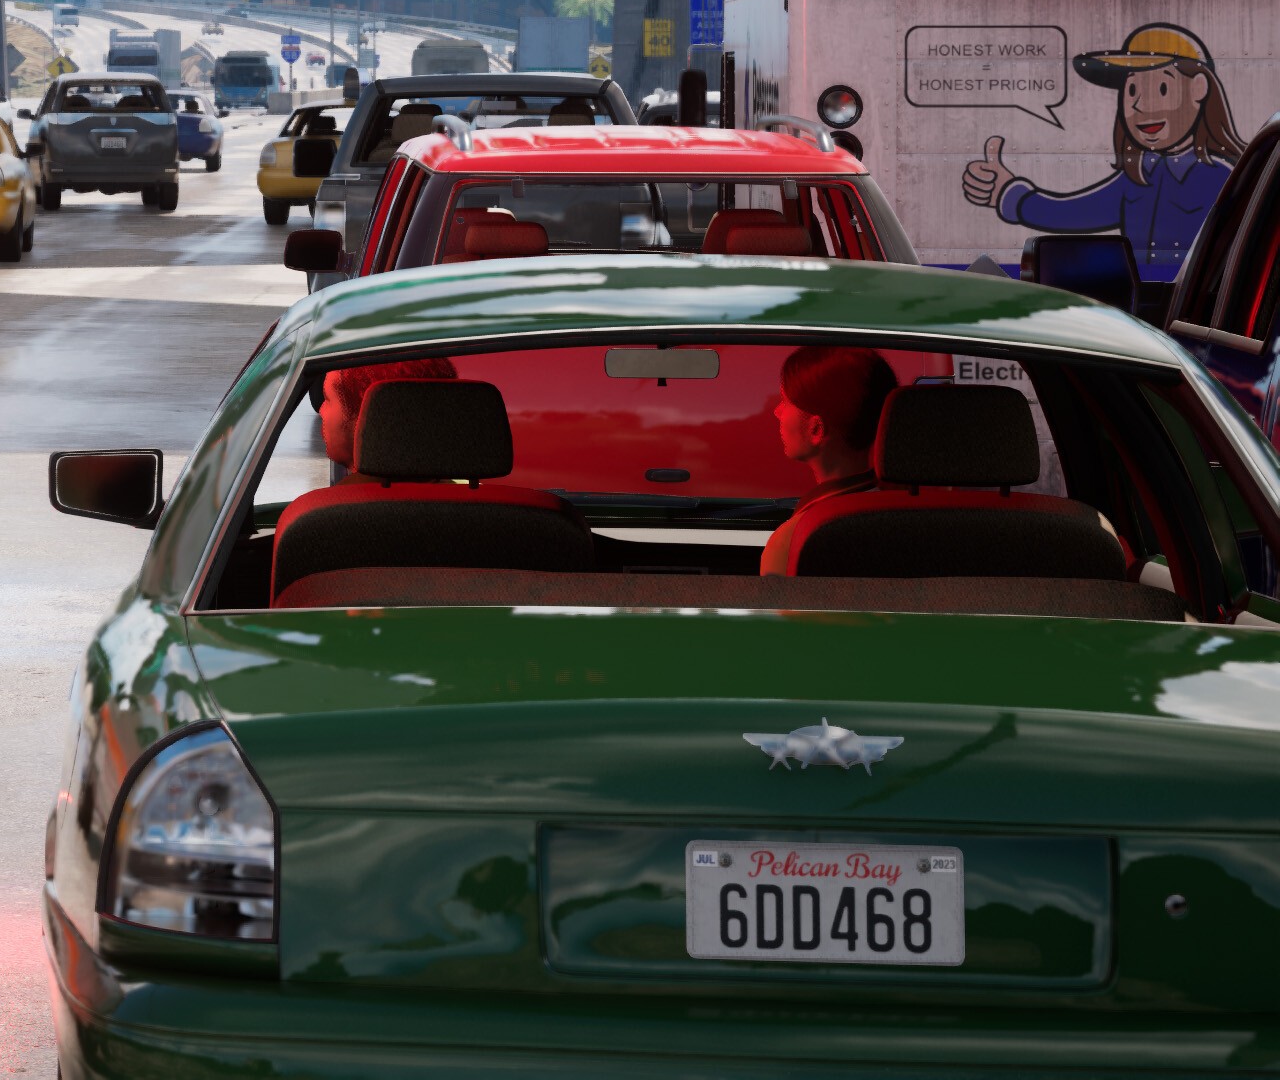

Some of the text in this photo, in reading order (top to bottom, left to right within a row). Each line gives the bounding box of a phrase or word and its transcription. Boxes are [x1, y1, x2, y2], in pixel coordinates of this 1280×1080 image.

[928, 44, 1047, 56] HONEST WORK
[919, 79, 1056, 91] HONEST PRICING
[696, 850, 956, 886] JUL Pelican Bay 2023
[720, 883, 931, 953] 6DD468
